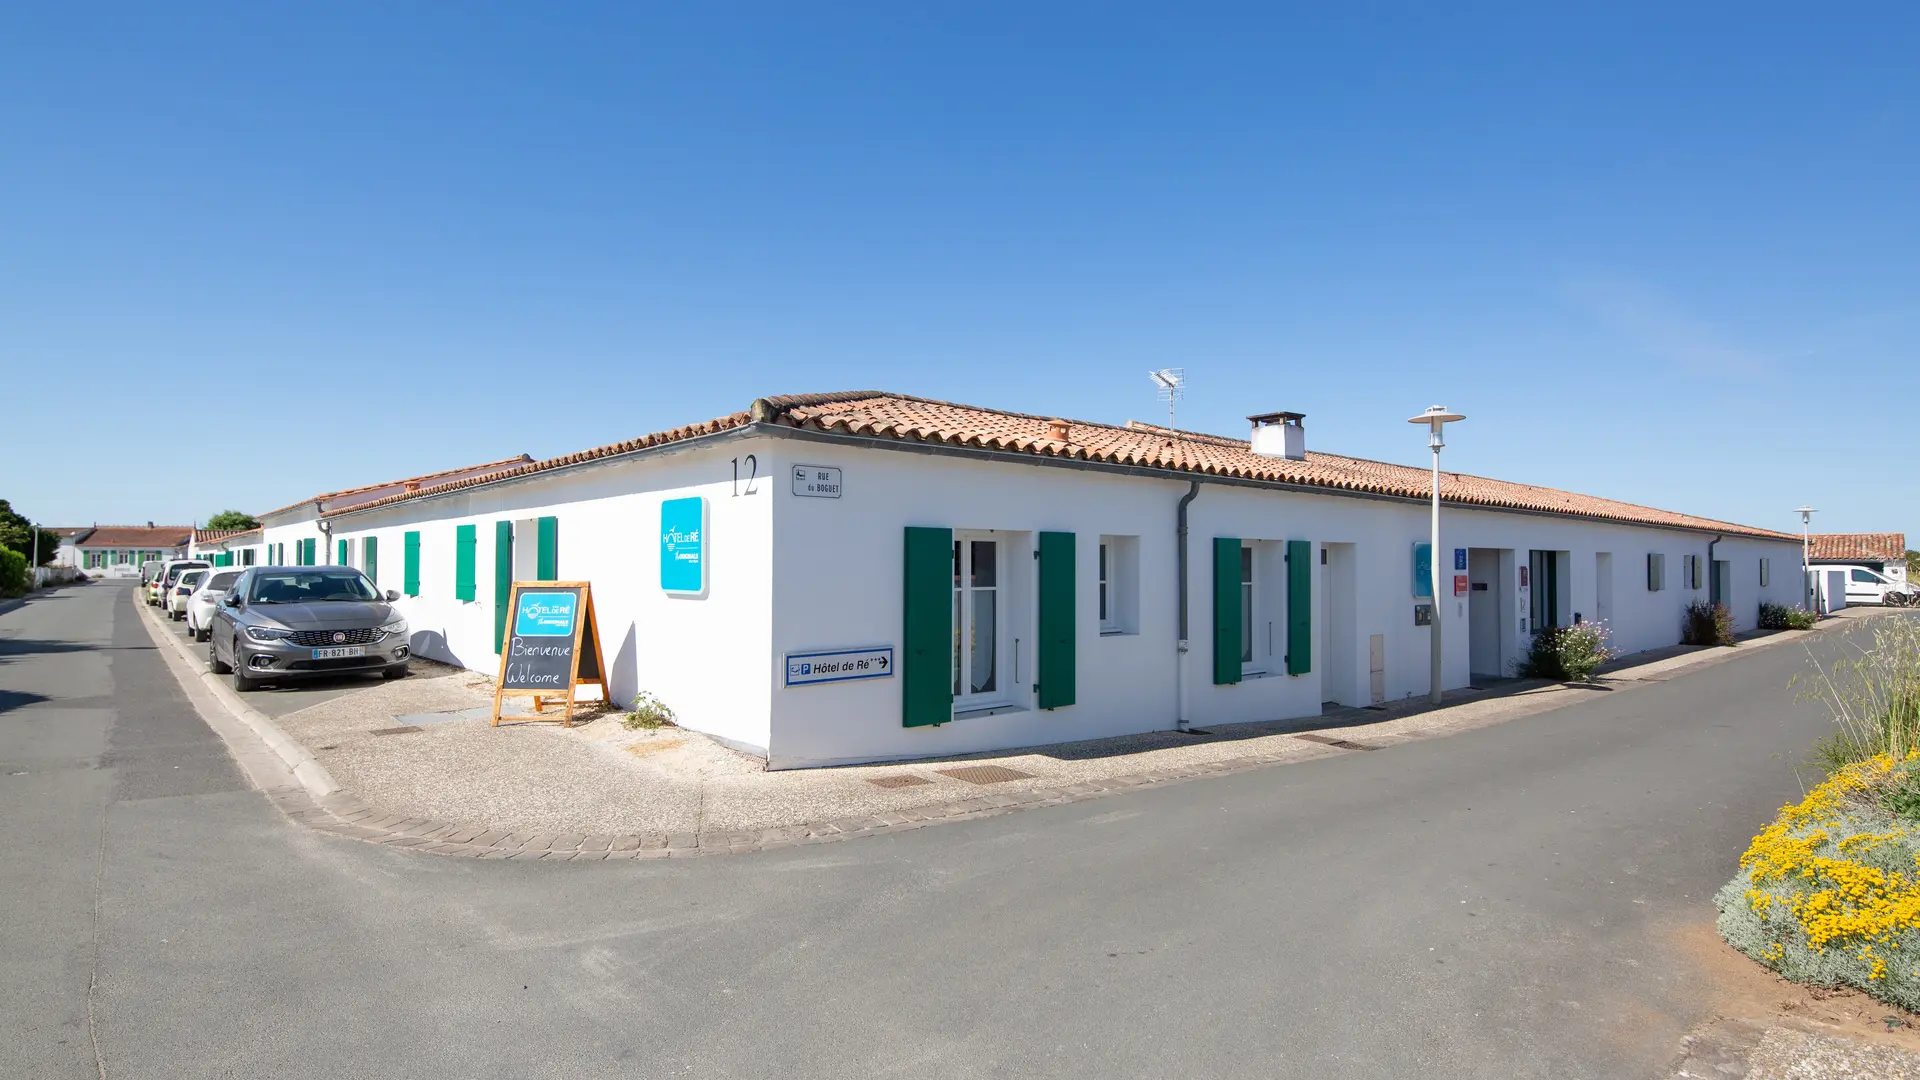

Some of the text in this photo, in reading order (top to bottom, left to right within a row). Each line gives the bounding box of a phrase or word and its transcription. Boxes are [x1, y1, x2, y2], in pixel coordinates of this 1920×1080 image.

[731, 454, 758, 497] 12
[817, 471, 829, 481] RUE
[807, 483, 839, 493] du BOGUET
[690, 528, 699, 542] RÉ
[511, 636, 571, 657] Bienvenue
[506, 662, 561, 684] Welcome
[813, 662, 840, 674] Hôtel
[842, 661, 854, 671] de
[856, 658, 870, 670] Ré
